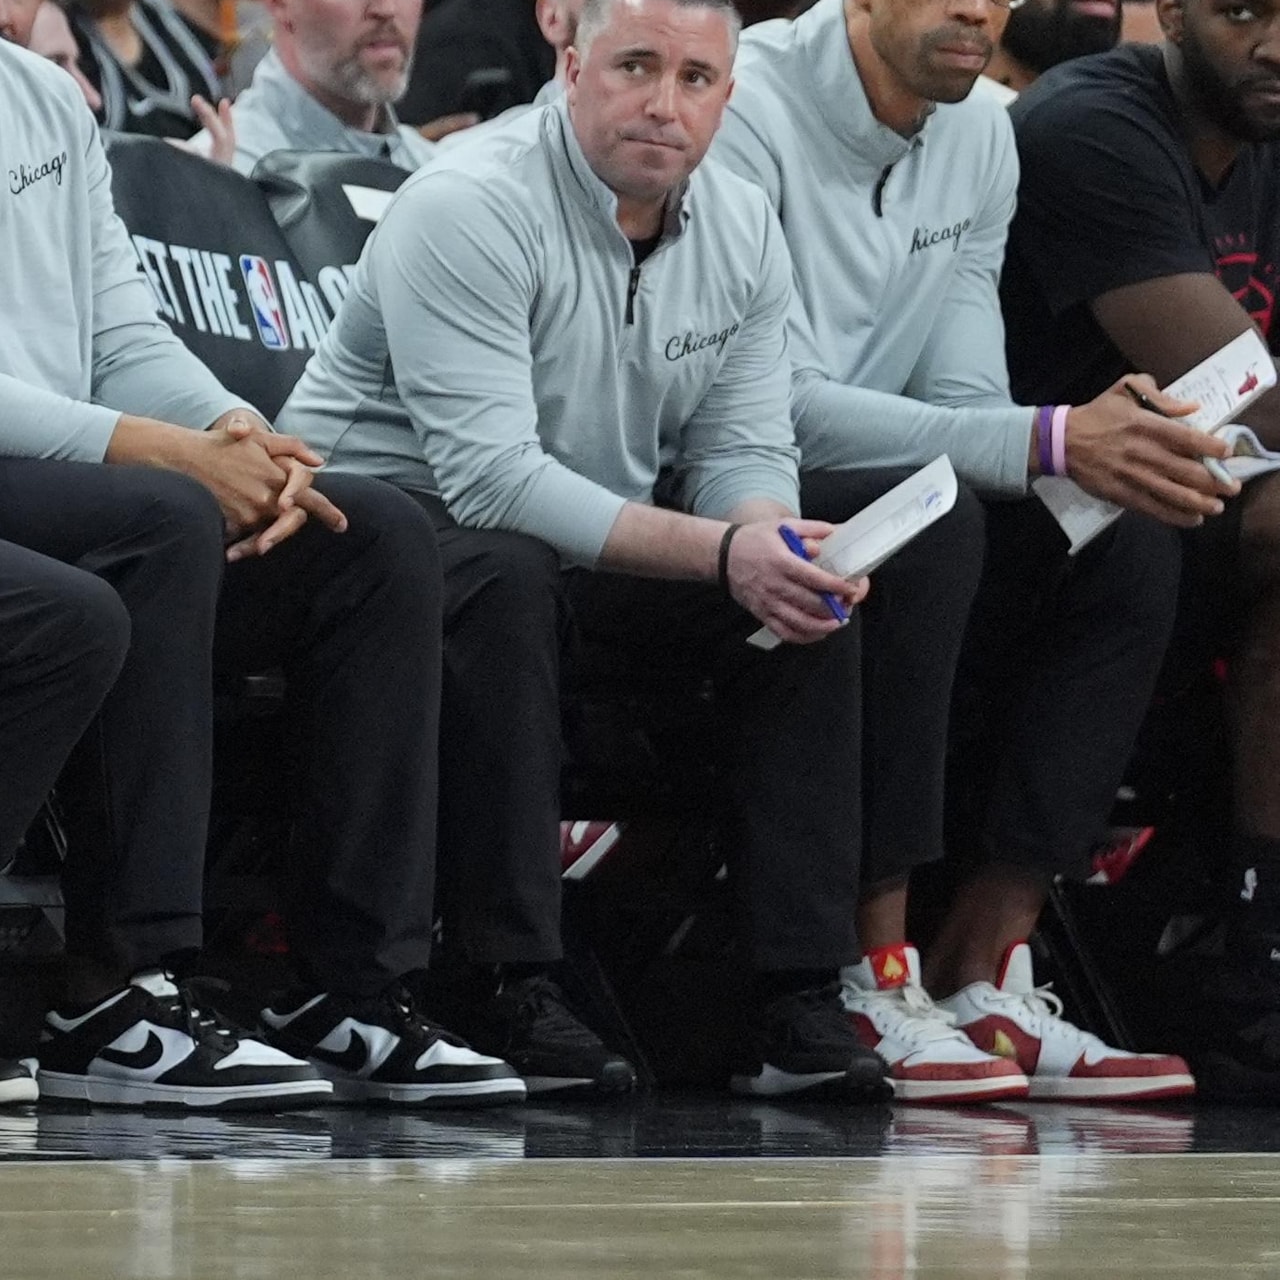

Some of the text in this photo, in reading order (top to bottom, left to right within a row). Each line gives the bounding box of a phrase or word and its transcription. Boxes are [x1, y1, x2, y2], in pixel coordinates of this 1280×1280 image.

[908, 217, 971, 254] hicago
[168, 244, 252, 341] THE
[665, 322, 740, 362] Chicago
